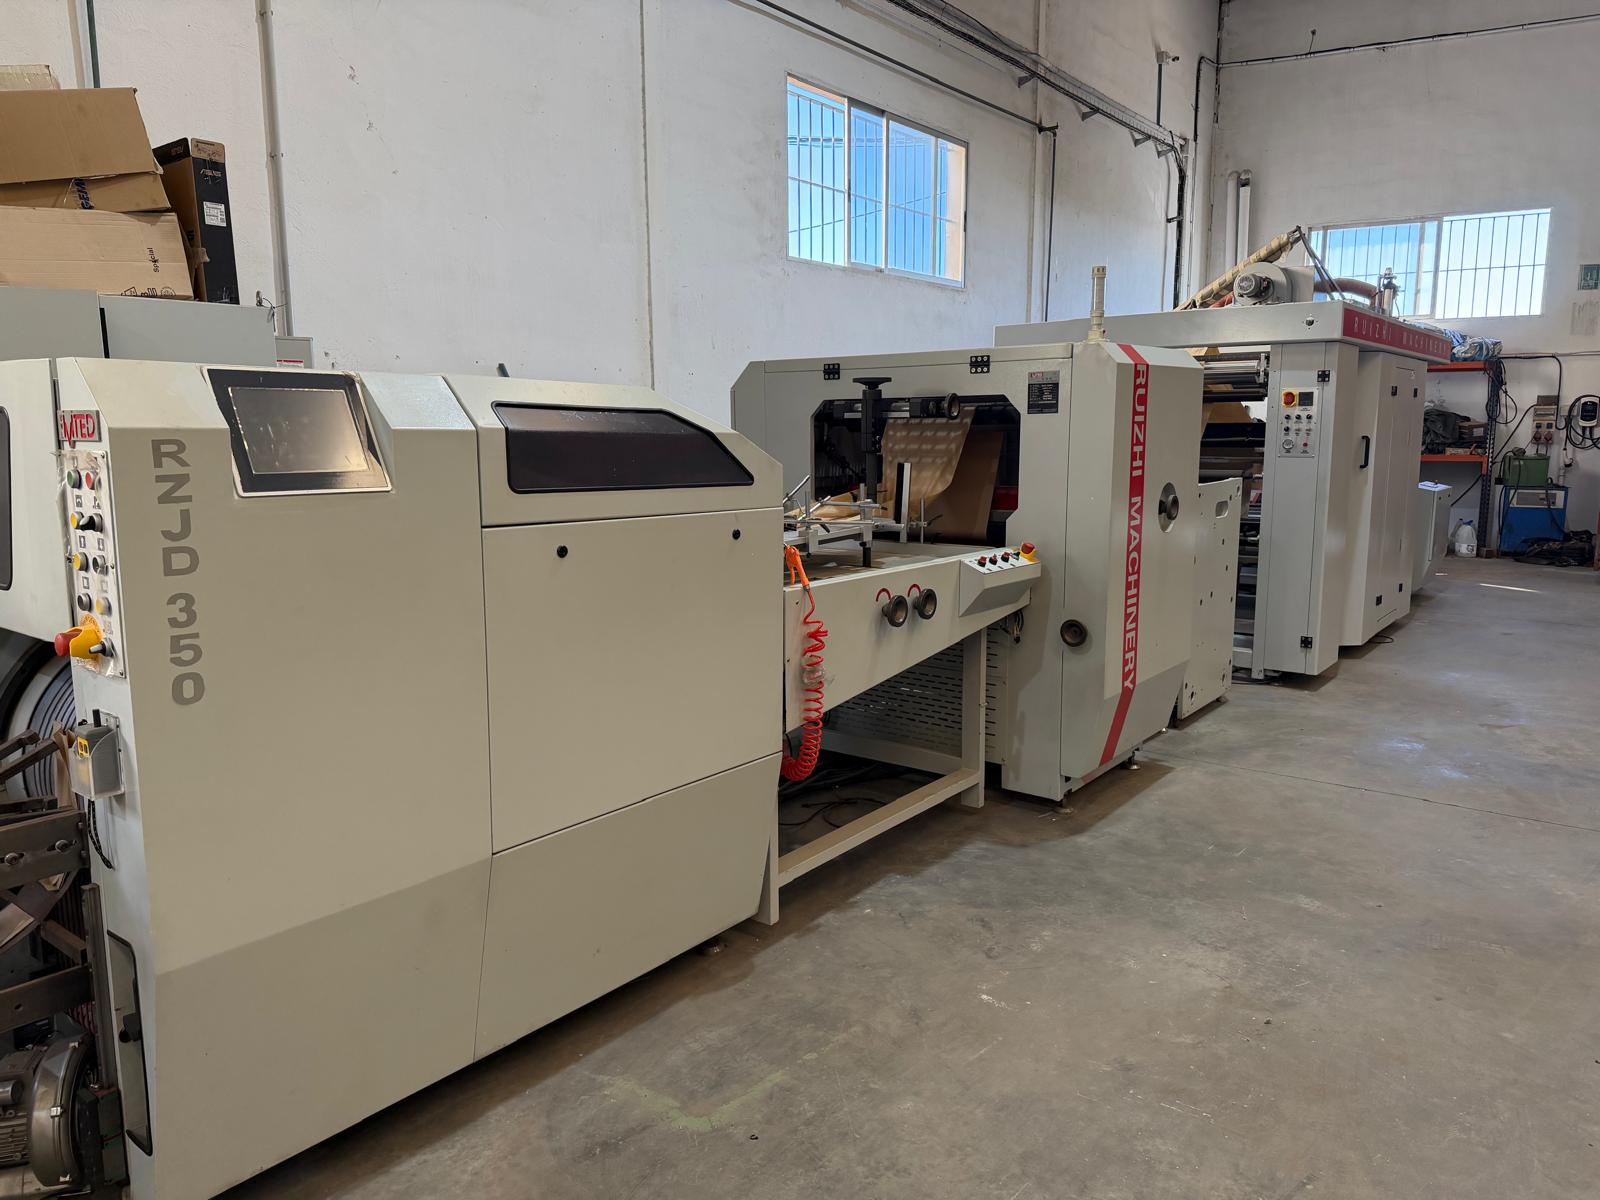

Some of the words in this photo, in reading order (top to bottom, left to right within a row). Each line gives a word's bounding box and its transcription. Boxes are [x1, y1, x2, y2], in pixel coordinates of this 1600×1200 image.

[1132, 364, 1147, 477] RUIZHI
[151, 438, 200, 577] RZJD
[166, 592, 205, 706] 350
[1123, 495, 1142, 690] MACHINERY
